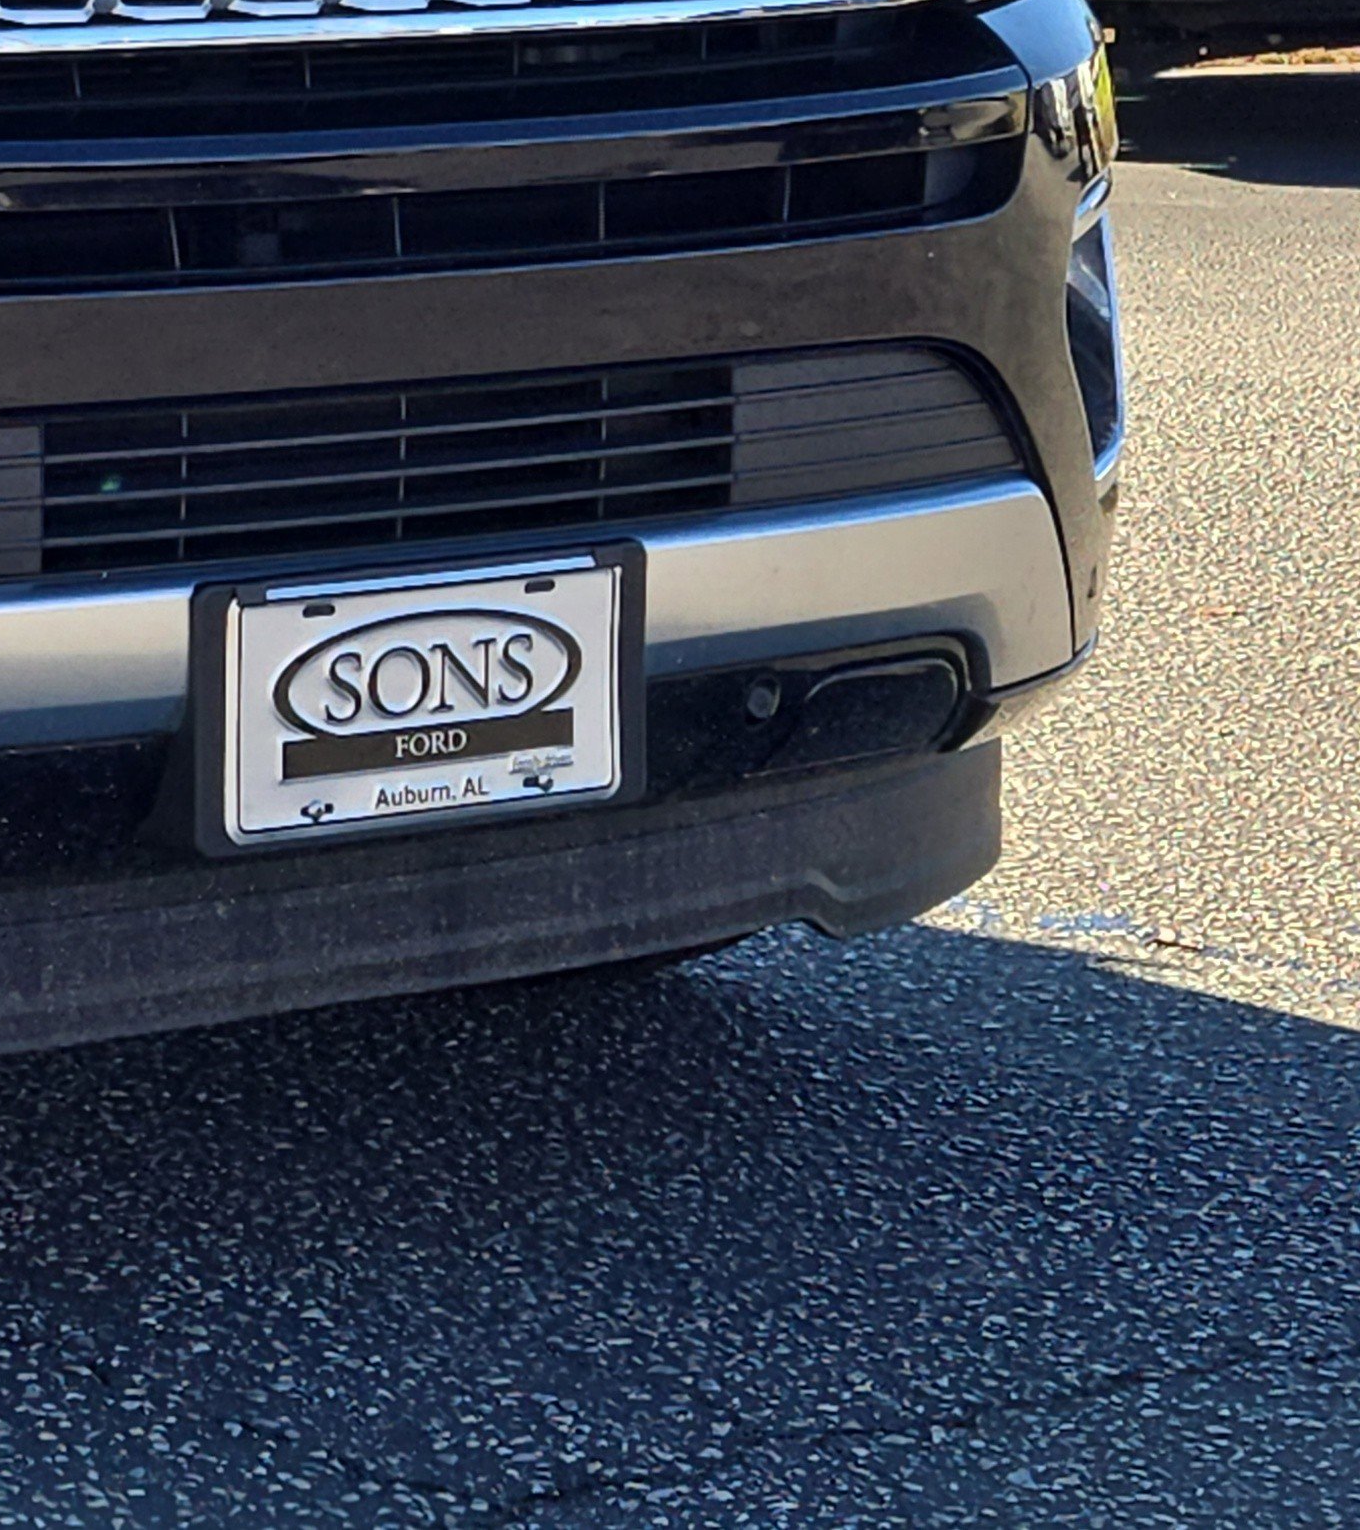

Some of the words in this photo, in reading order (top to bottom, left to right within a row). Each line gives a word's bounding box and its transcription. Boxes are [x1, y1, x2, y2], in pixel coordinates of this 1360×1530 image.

[323, 632, 534, 725] SONS
[394, 726, 468, 759] FORD
[375, 784, 457, 810] Auburn,
[462, 774, 491, 798] AL
